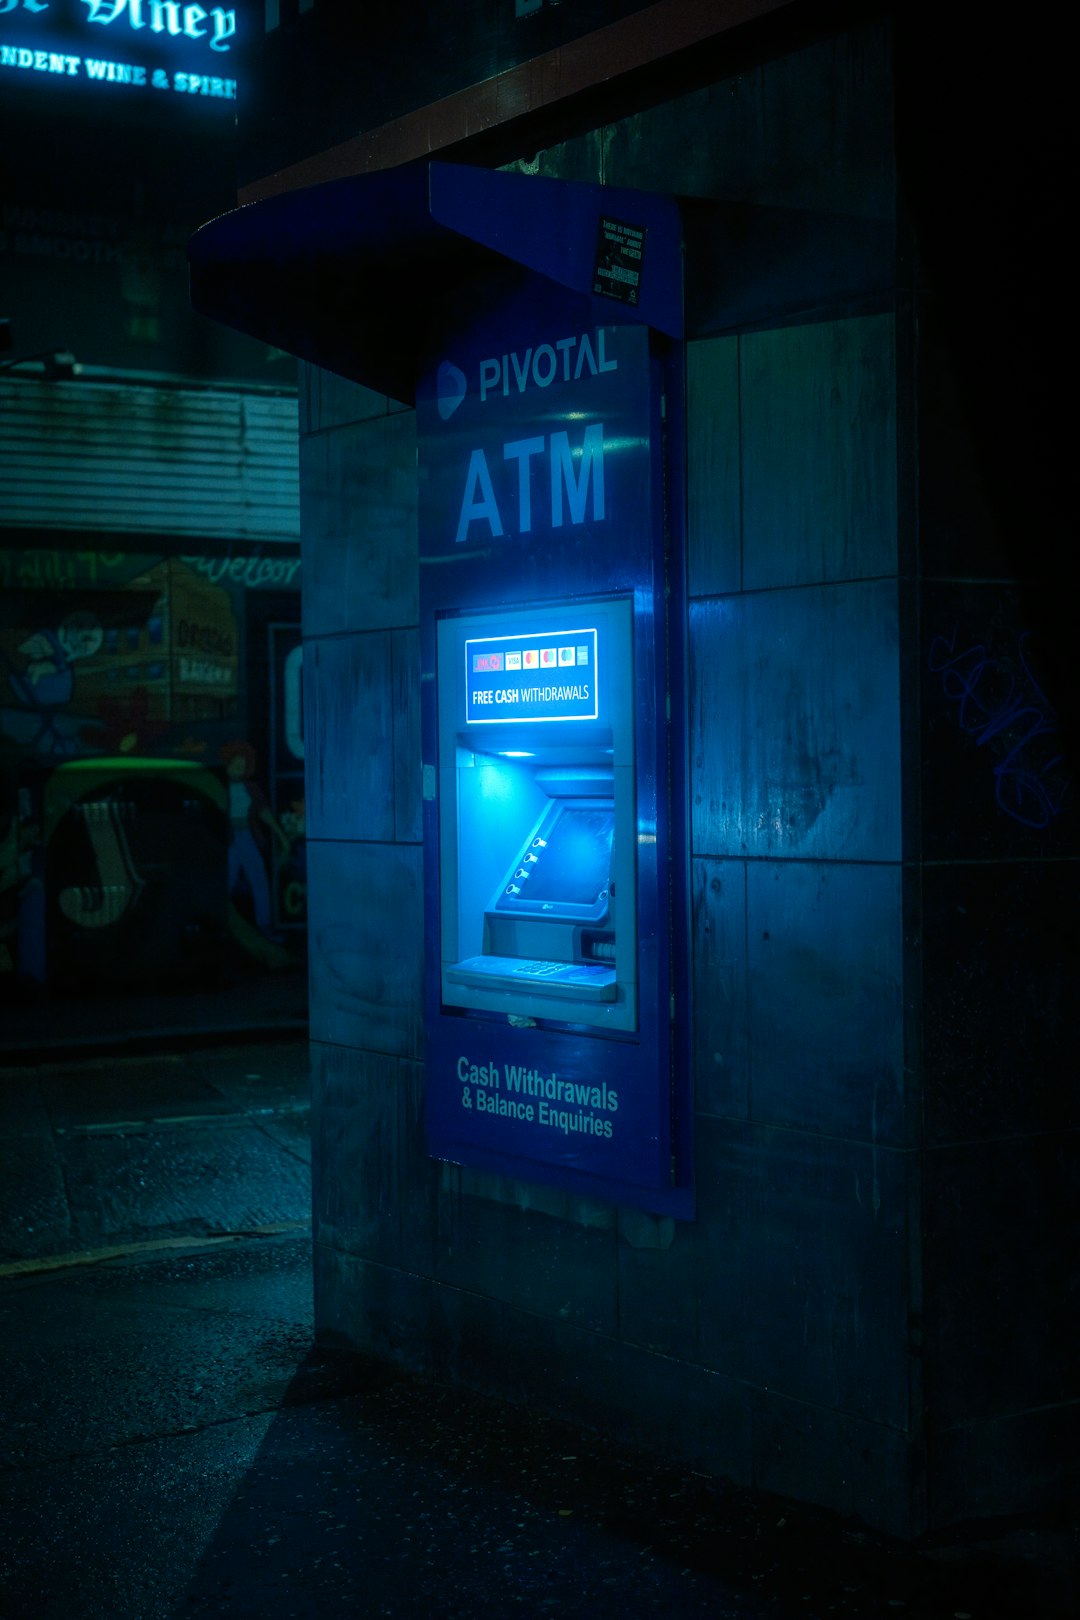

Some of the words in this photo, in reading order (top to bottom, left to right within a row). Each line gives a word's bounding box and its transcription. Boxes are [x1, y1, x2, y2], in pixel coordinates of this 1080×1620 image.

[84, 58, 147, 86] WINE
[151, 68, 170, 90] &
[479, 328, 618, 402] PIVOTAL
[455, 422, 605, 543] ATM
[472, 690, 494, 705] FREE
[495, 688, 519, 704] CASH
[520, 685, 589, 703] WITHDRAWALS
[457, 1056, 500, 1089] Cash
[504, 1064, 619, 1112] Withdrawals
[461, 1086, 473, 1109] &
[476, 1088, 535, 1122] Balance
[538, 1101, 613, 1138] Enquiries
